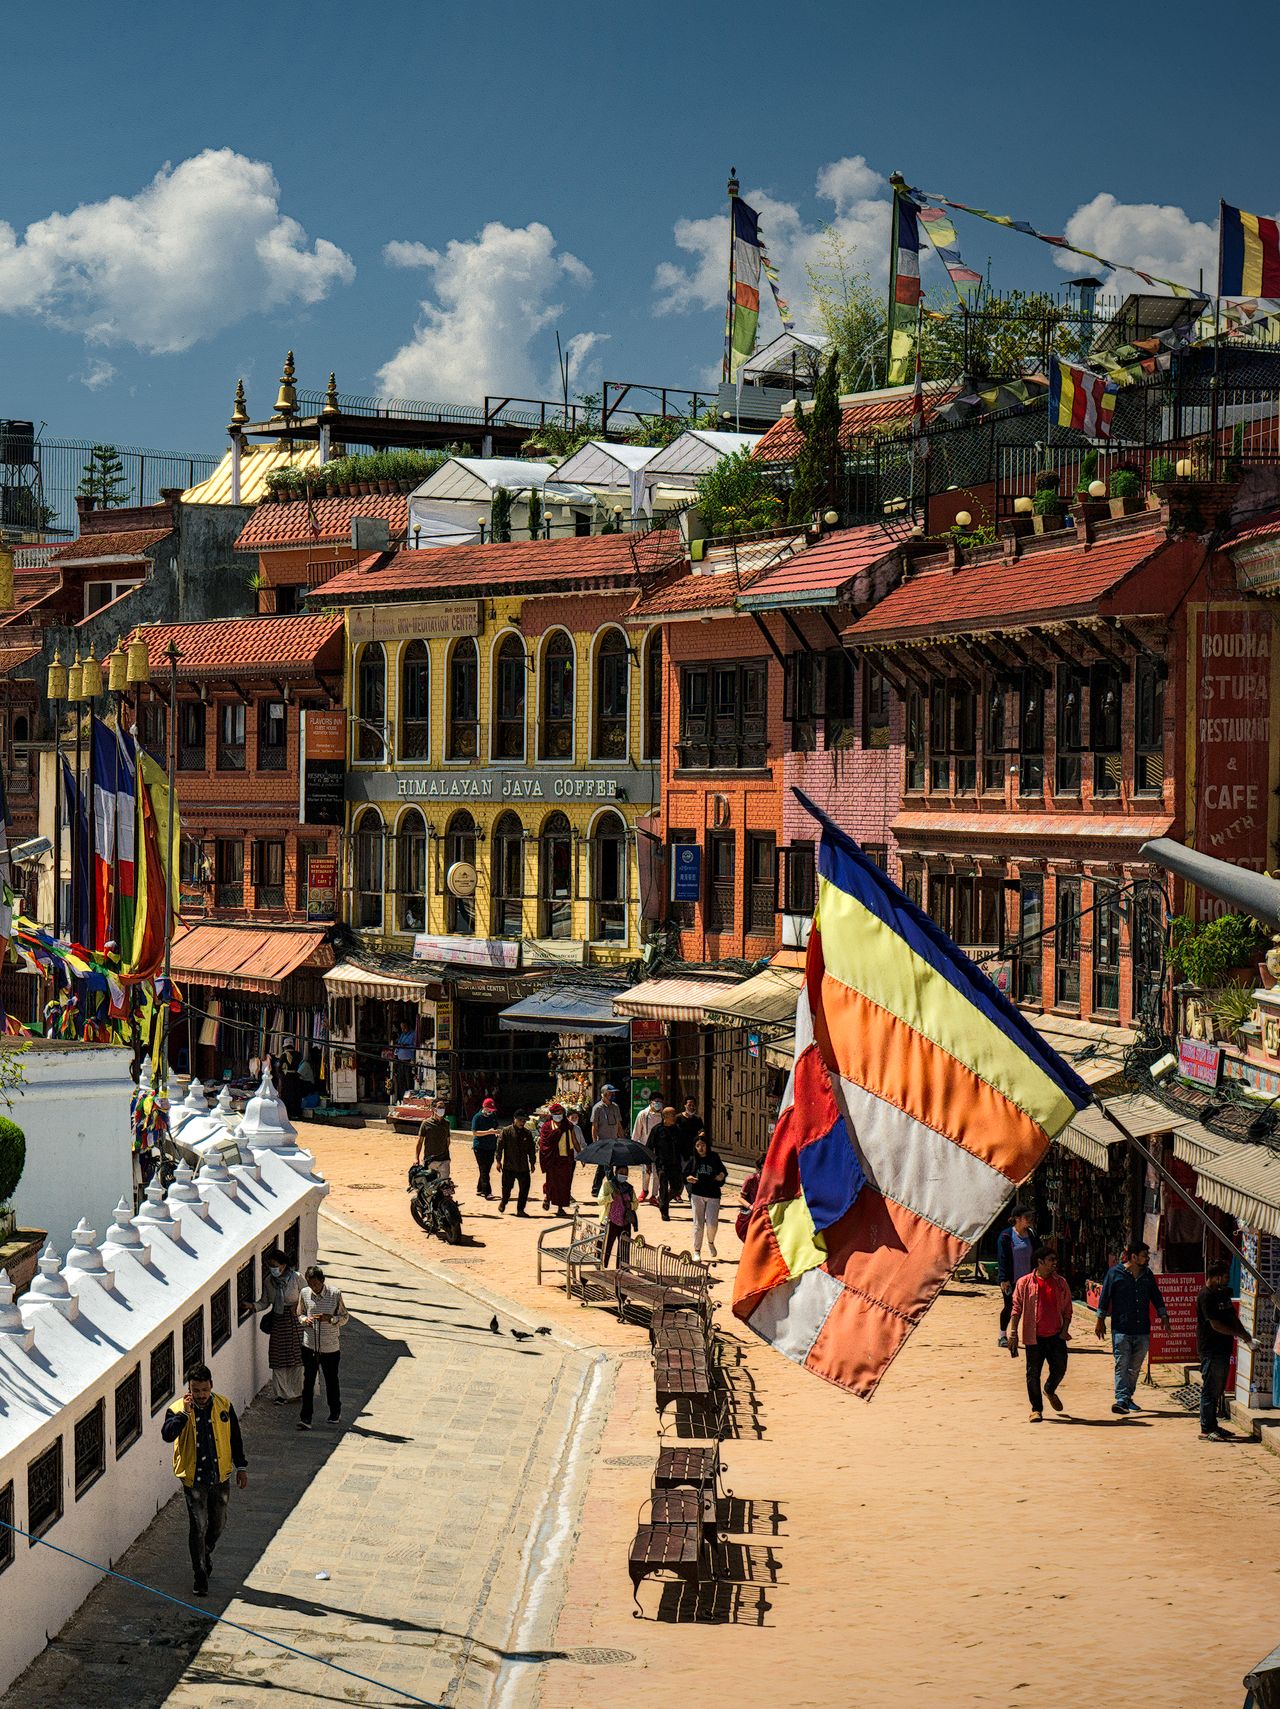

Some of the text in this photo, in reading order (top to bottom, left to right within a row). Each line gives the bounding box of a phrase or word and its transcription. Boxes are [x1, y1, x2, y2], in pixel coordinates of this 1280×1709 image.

[1201, 633, 1269, 658] BOUDHA
[1201, 675, 1268, 700] STUPA
[310, 717, 332, 725] FLAVORS
[1200, 718, 1269, 742] RESTAURANT
[1226, 757, 1238, 771] &
[397, 779, 618, 797] HIMALAYAN JAVA COFFEE
[1204, 784, 1259, 810] CAFE
[1210, 815, 1256, 847] WITH
[1158, 1277, 1196, 1285] BOUDHA STUPA
